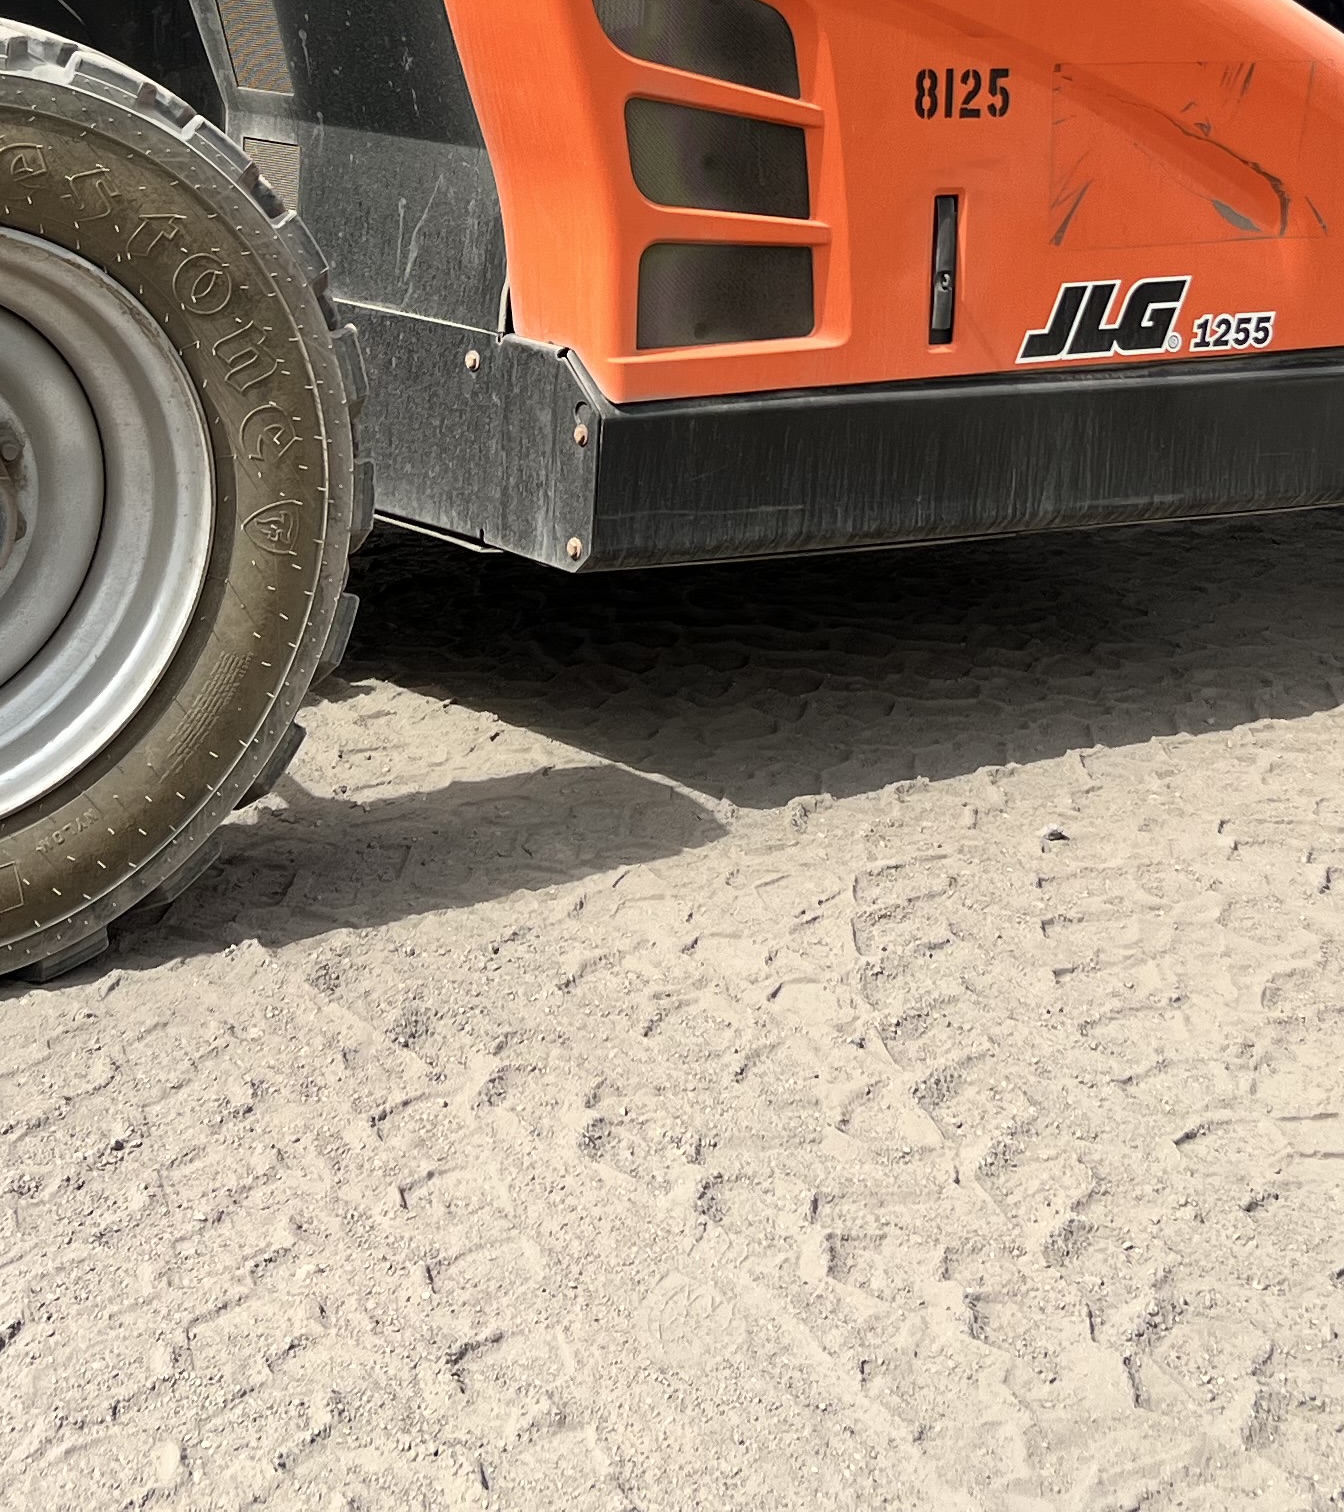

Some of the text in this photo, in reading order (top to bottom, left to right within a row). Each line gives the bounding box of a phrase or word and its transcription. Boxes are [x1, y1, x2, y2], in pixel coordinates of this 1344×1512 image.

[915, 69, 1009, 119] 8125
[1017, 277, 1272, 362] JLG 1255
